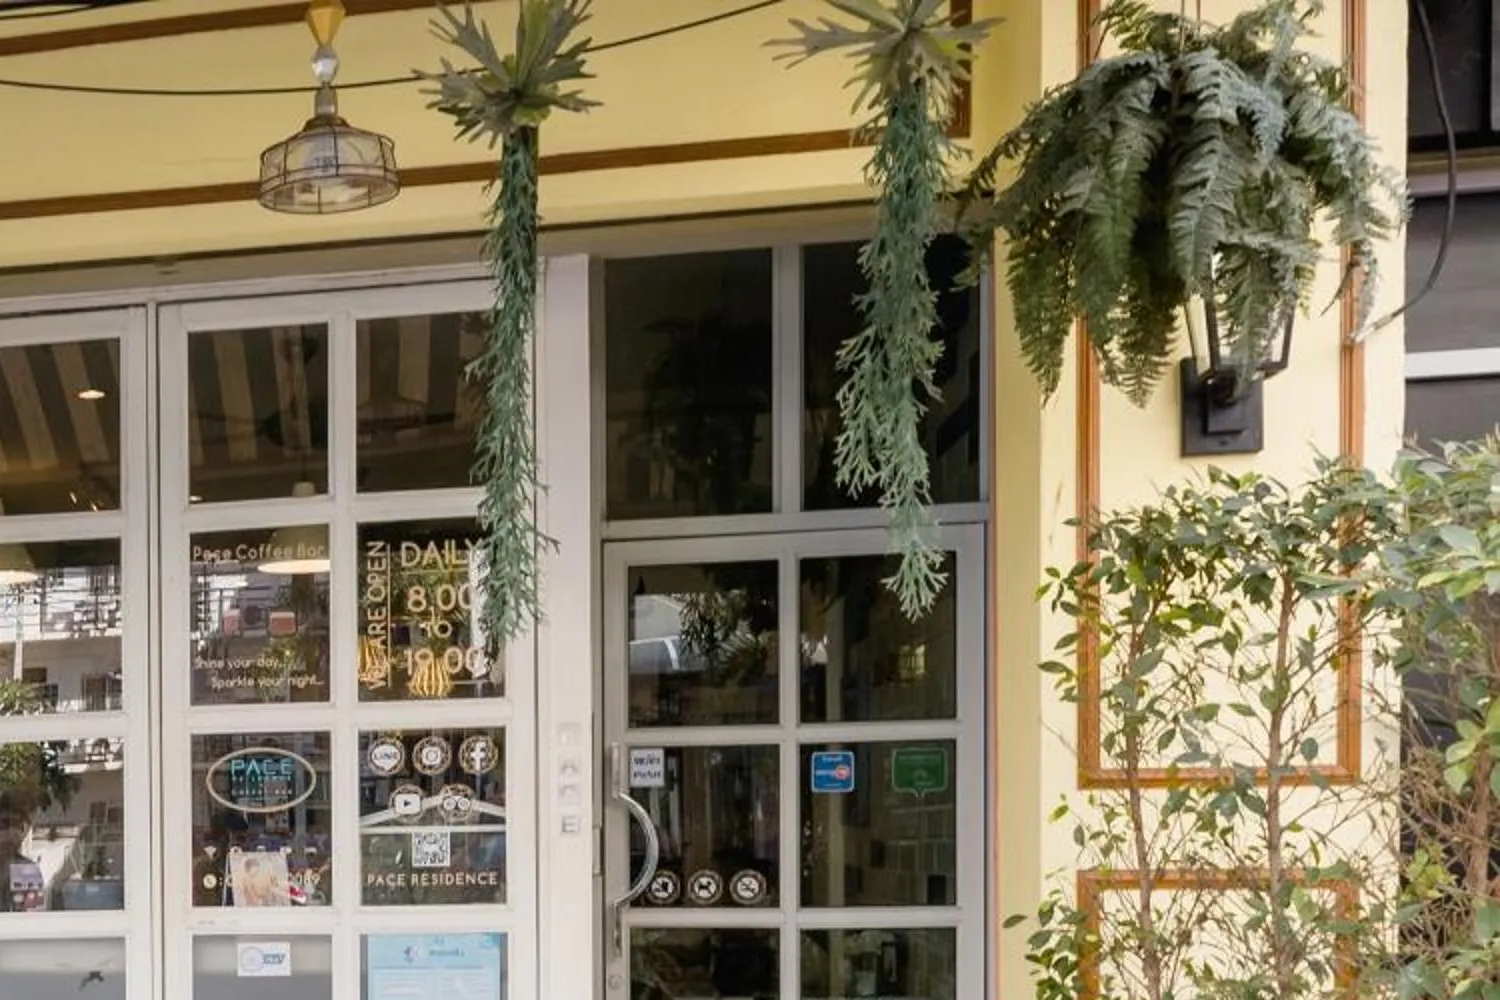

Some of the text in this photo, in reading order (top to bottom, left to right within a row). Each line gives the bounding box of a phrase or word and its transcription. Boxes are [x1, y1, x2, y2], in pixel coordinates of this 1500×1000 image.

[236, 544, 292, 560] Coffee
[401, 538, 483, 571] DAILY
[367, 541, 387, 603] OPEN
[231, 758, 292, 776] PACE
[367, 871, 499, 887] PACE RESIDENCE
